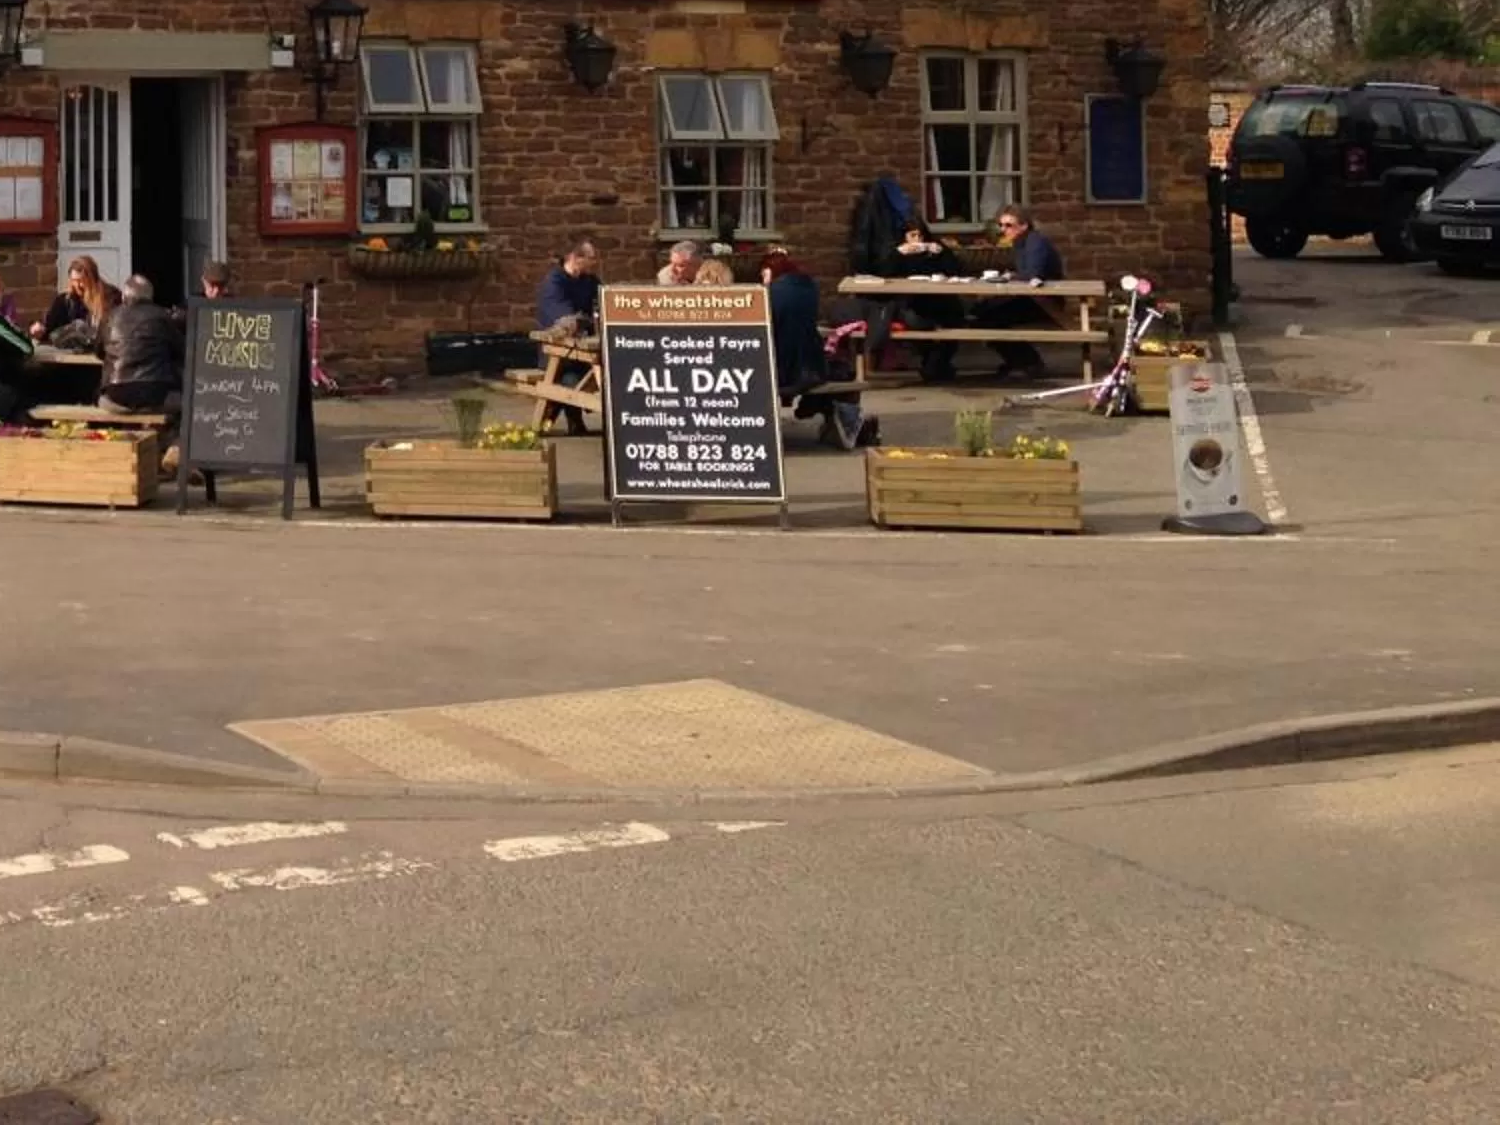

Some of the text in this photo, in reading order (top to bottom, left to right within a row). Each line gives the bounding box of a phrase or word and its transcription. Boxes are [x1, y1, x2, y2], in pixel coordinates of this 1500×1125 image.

[614, 293, 753, 309] the wheatsheaf
[213, 310, 272, 340] LIVE
[615, 335, 761, 352] Home Cooked Fayre
[205, 338, 276, 370] MUSIC
[664, 351, 714, 365] Served
[627, 368, 755, 394] ALL DAY
[684, 396, 698, 408] 12
[621, 412, 766, 427] Families Welcome
[666, 430, 727, 443] Telephone
[625, 443, 768, 461] 01788 823 824
[639, 461, 756, 473] FOR TABLE BOOKINGS
